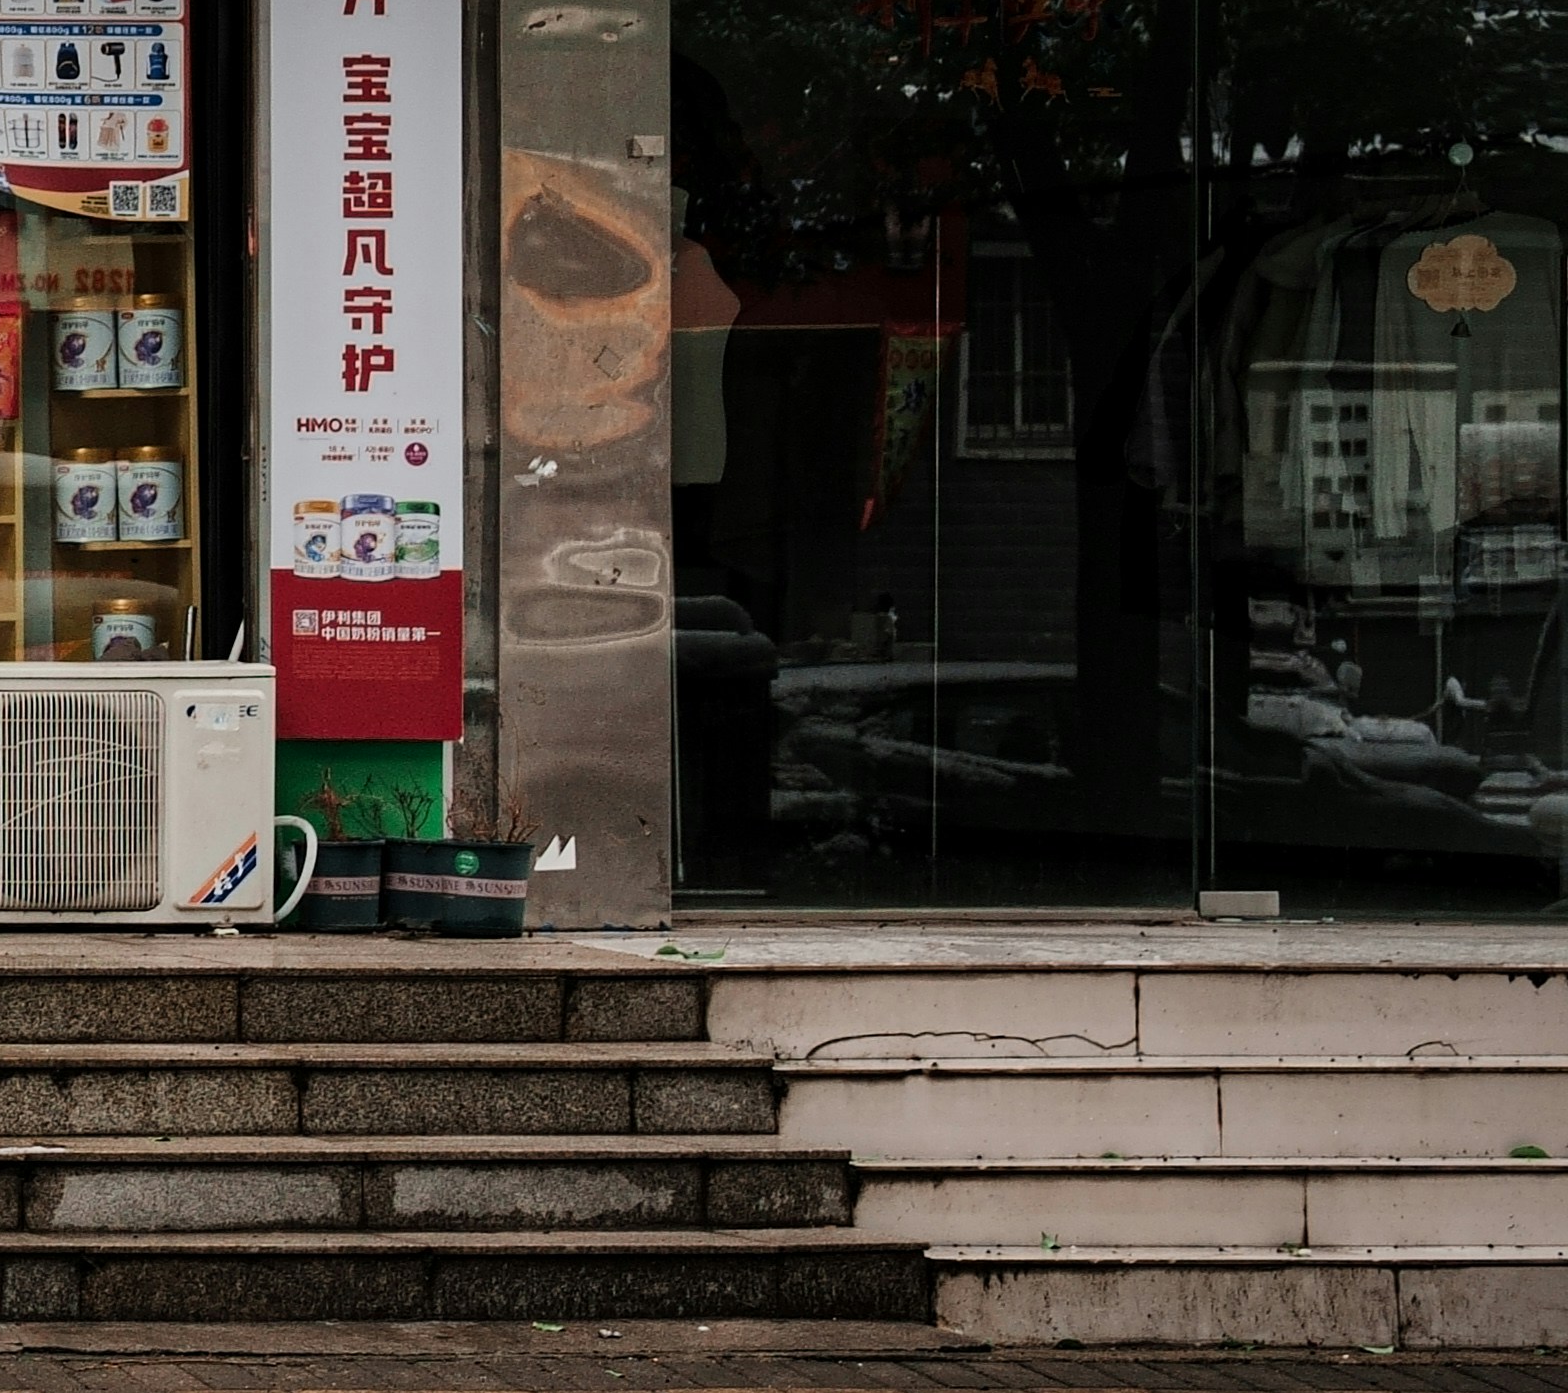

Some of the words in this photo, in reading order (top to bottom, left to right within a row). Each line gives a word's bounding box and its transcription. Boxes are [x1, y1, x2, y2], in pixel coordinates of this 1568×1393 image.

[342, 54, 394, 393] 宝宝超凡守护
[297, 418, 343, 433] HMO
[321, 610, 381, 625] 伊利集团
[321, 626, 441, 642] 中国奶粉销量第一
